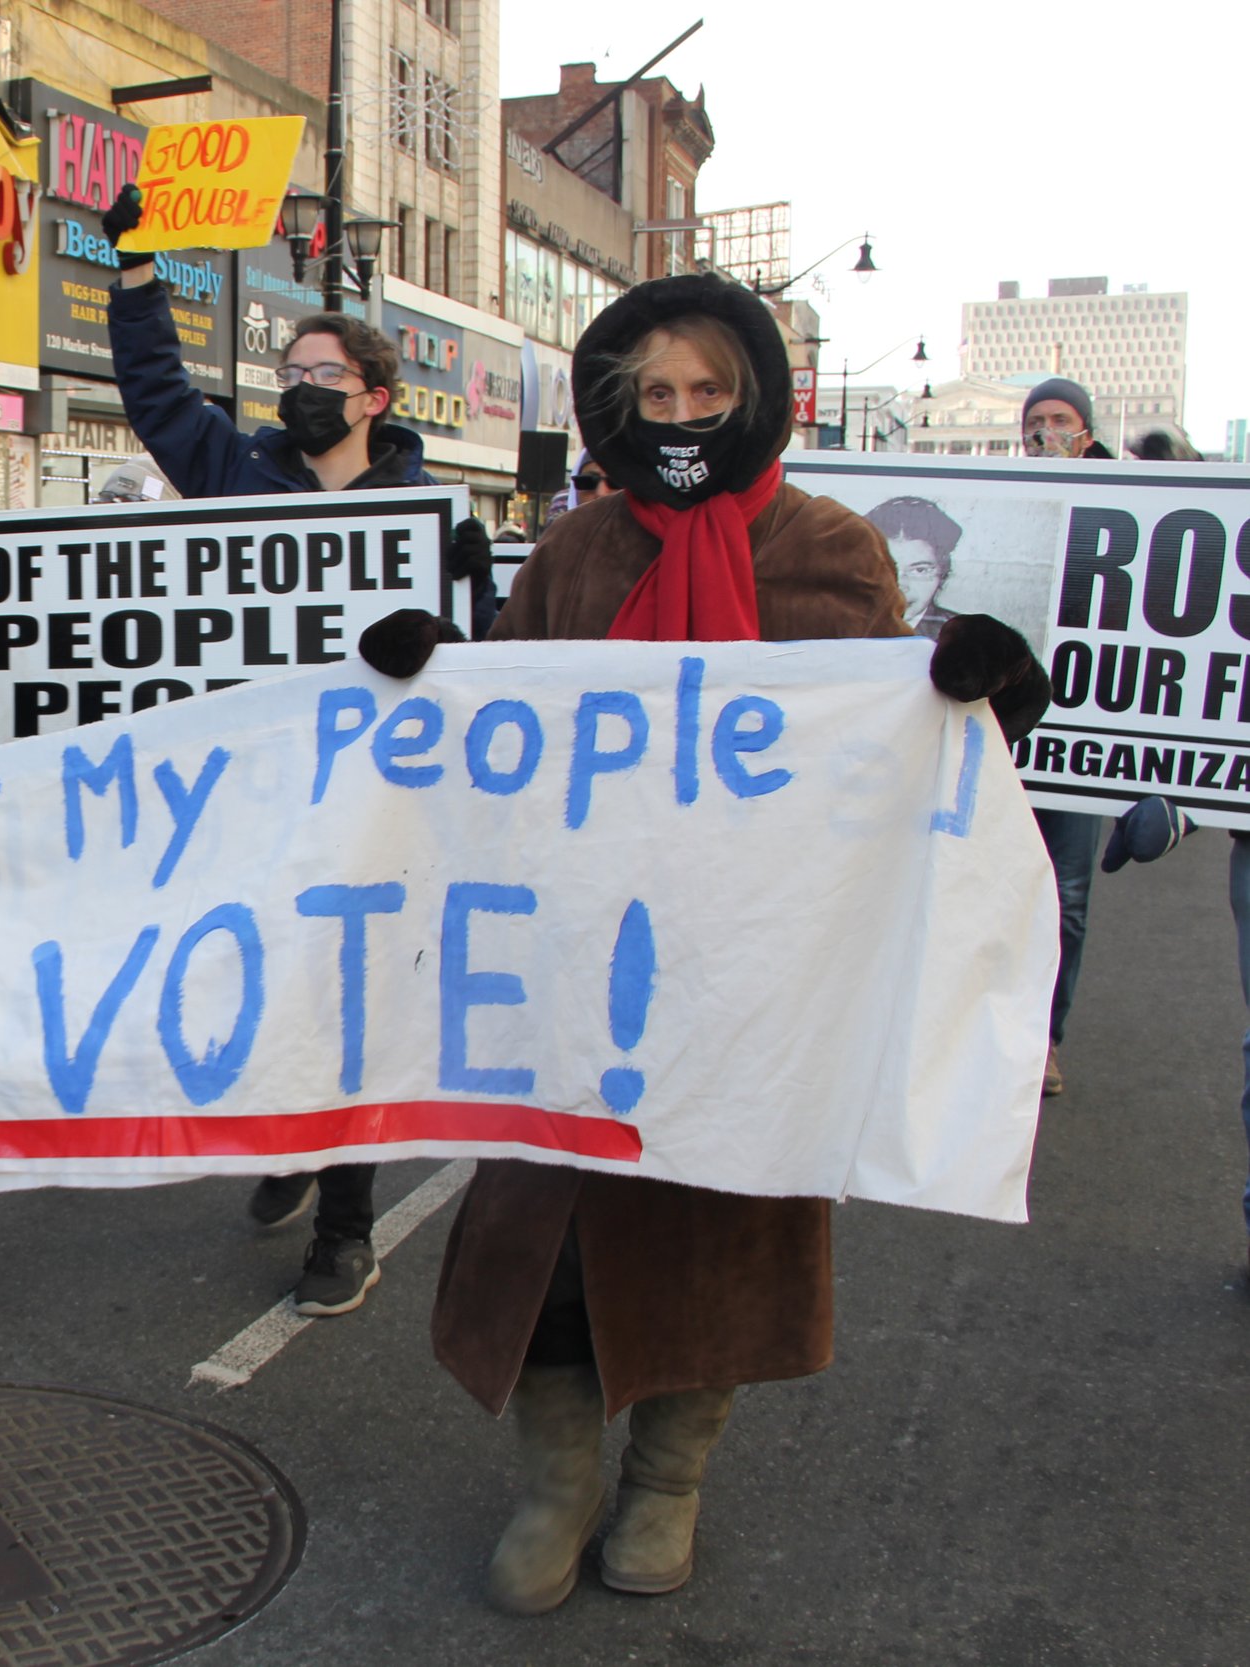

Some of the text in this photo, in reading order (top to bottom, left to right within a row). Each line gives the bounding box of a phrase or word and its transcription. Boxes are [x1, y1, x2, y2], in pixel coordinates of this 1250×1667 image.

[145, 123, 250, 175] GOOD
[138, 176, 276, 232] TROUBLE
[61, 280, 111, 306] WIGS-EXT
[154, 251, 223, 305] Supply
[399, 324, 458, 372] TOP
[391, 380, 464, 428] 2000
[793, 391, 813, 422] WIG
[66, 420, 117, 451] HAIR
[659, 445, 701, 458] PROTECT
[656, 461, 710, 489] VOTE!
[58, 538, 167, 601] THE
[185, 528, 414, 596] PEOPLE
[1057, 506, 1250, 642] RO
[1051, 640, 1187, 718] OUR
[62, 733, 231, 889] My
[312, 656, 798, 832] People
[31, 881, 659, 1116] VOTE!
